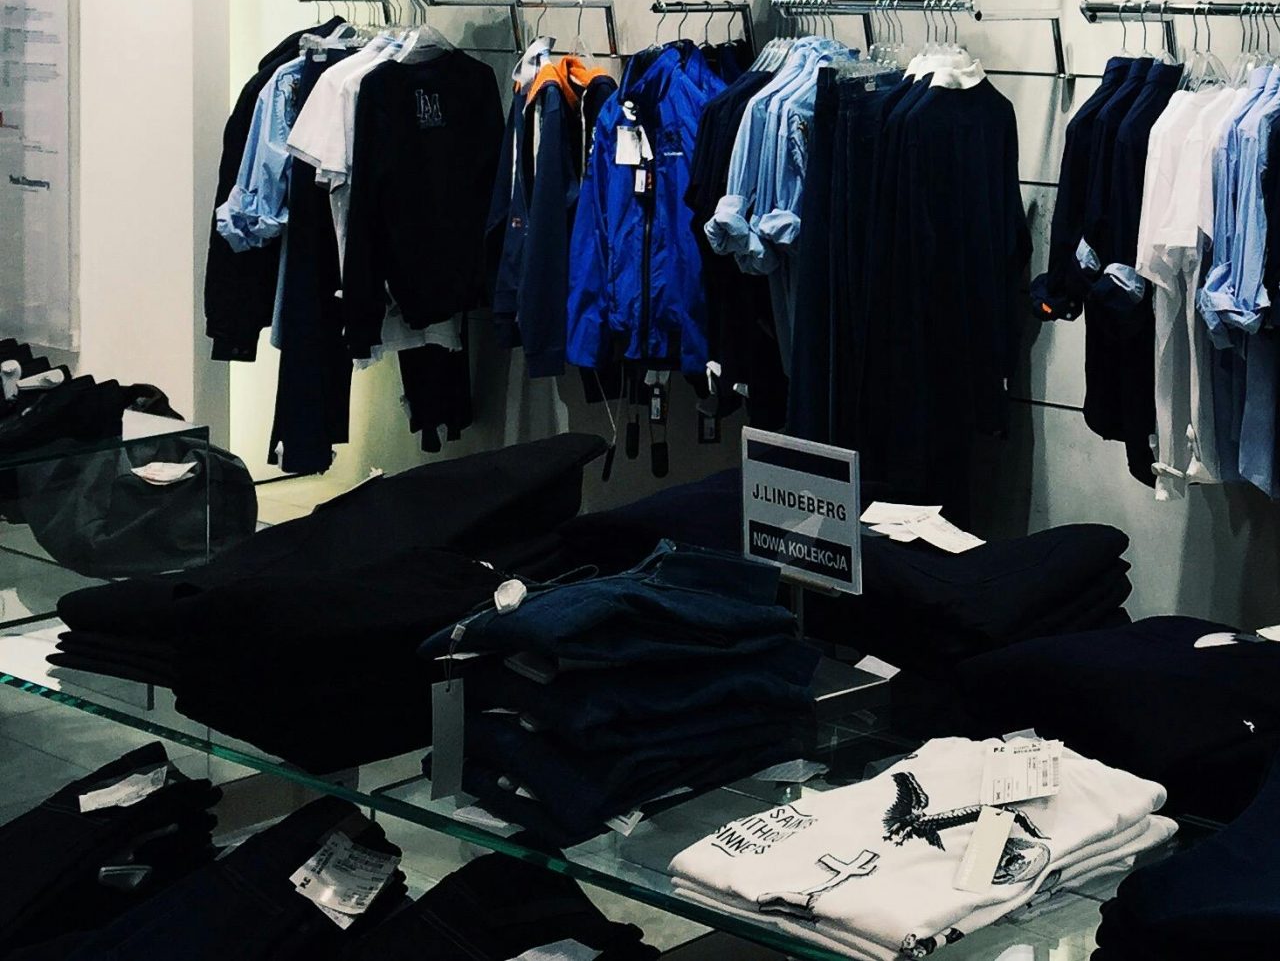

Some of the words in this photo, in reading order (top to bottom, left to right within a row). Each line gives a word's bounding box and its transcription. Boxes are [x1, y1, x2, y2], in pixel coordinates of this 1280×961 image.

[752, 483, 847, 522] J.LINDEBERG
[752, 531, 786, 554] NOWA
[787, 540, 849, 572] KOLEKCJA
